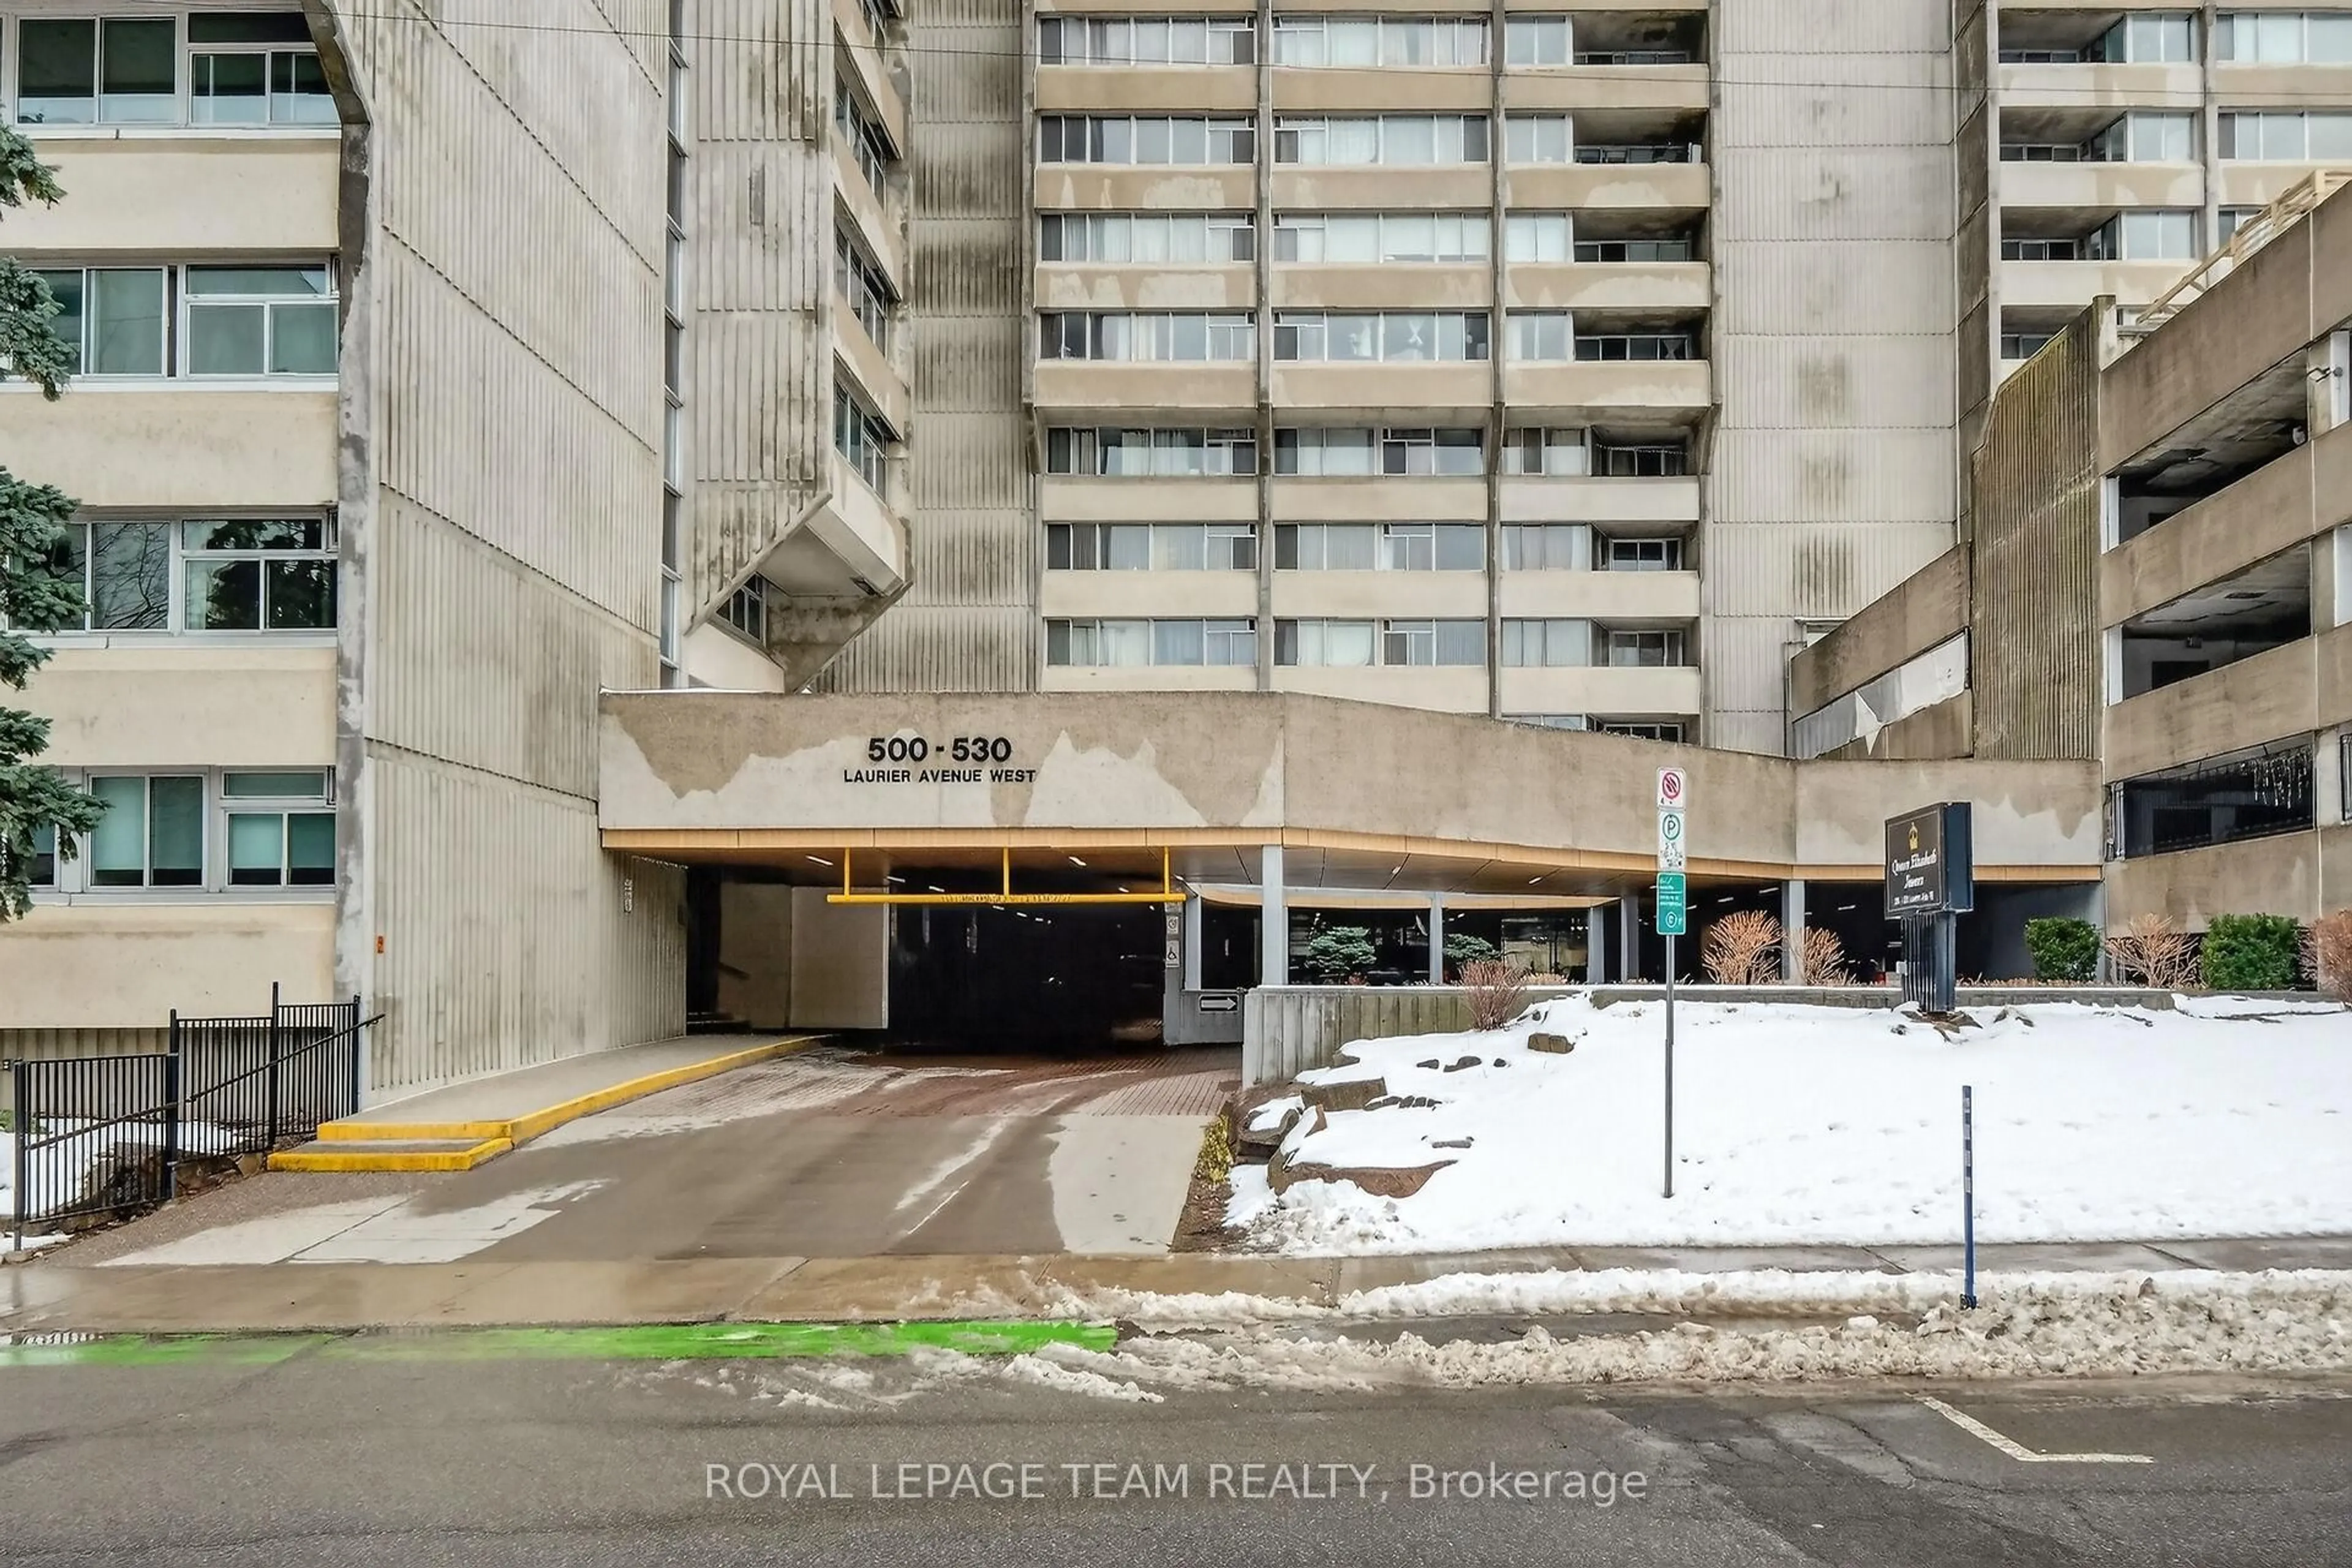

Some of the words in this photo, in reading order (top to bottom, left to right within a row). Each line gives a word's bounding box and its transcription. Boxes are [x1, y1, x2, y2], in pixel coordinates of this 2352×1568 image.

[868, 737, 928, 762] 500
[952, 737, 1012, 762] 530
[843, 769, 911, 783] LAURIER
[919, 769, 981, 783] AVENUE
[990, 769, 1036, 783] WEST
